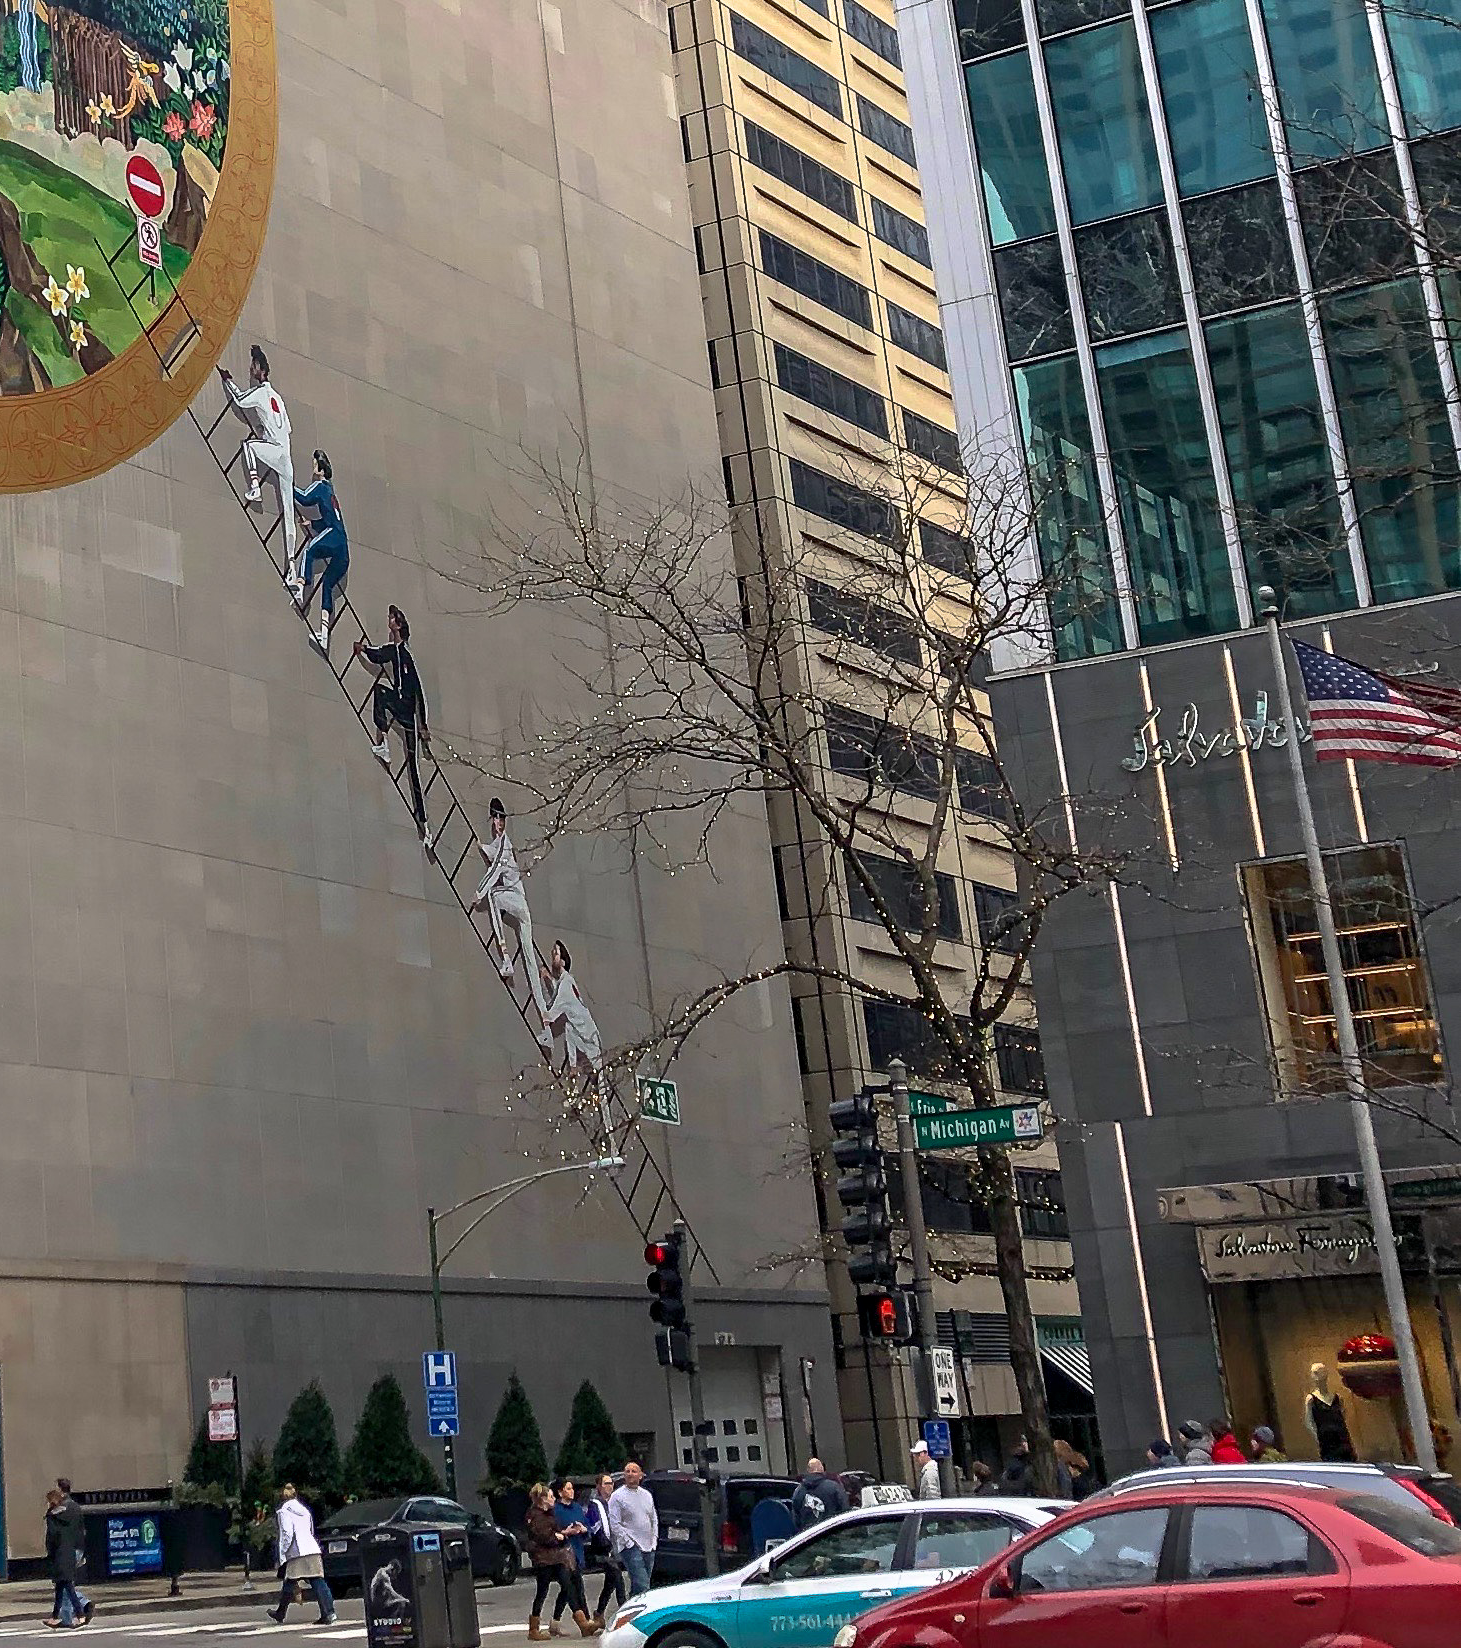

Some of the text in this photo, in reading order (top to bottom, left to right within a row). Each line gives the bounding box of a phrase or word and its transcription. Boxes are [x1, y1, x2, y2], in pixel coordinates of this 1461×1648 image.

[931, 1118, 997, 1141] Michigan
[1000, 1118, 1011, 1129] Av
[427, 1354, 452, 1386] H
[935, 1352, 953, 1370] ONE
[937, 1372, 955, 1389] WAY
